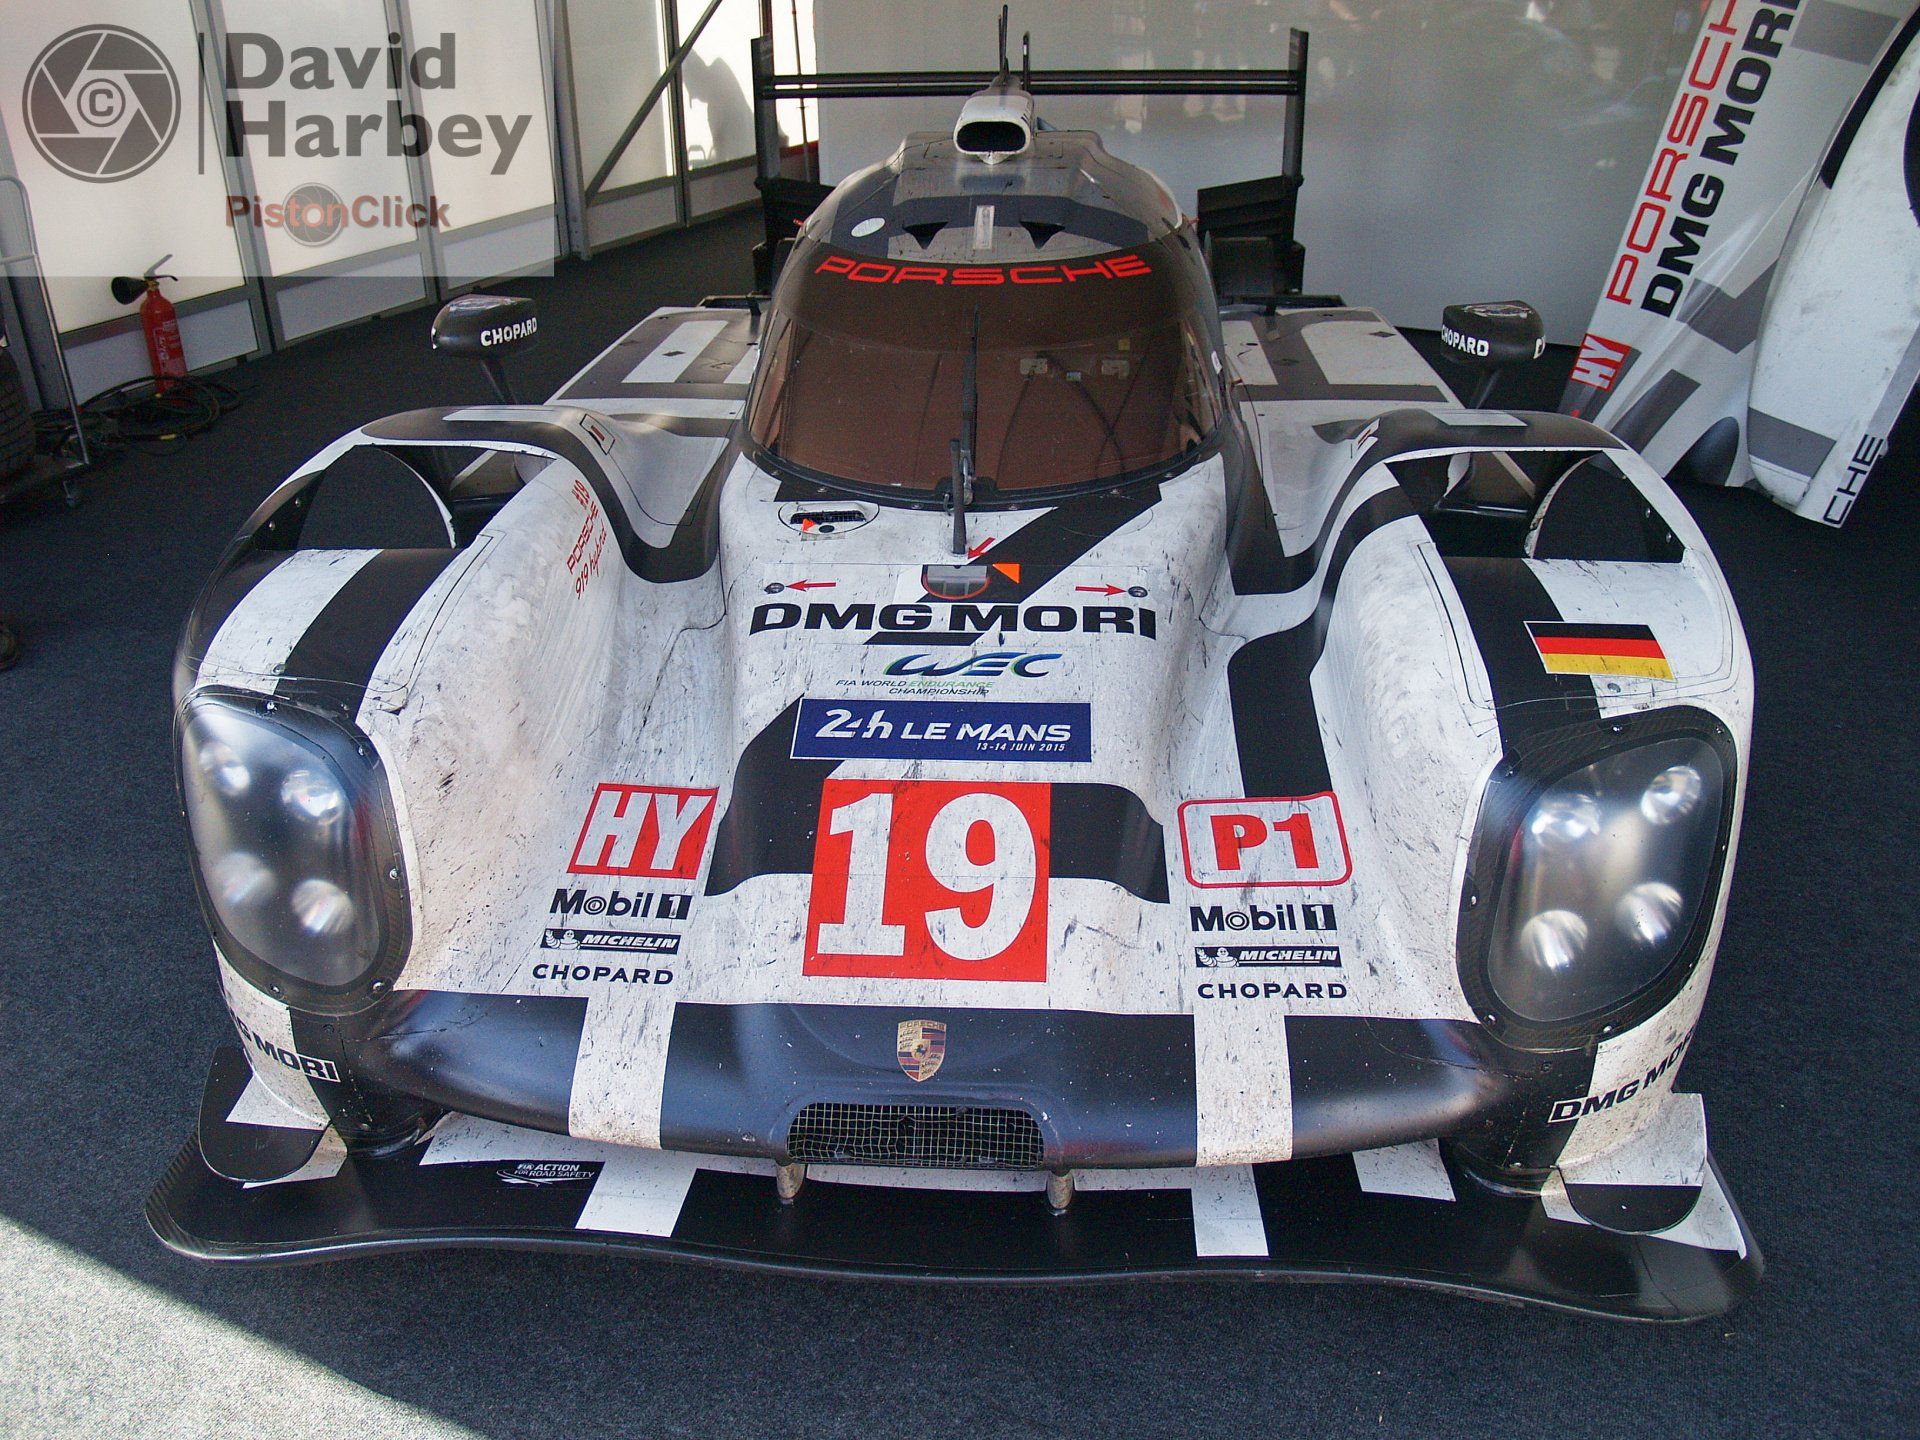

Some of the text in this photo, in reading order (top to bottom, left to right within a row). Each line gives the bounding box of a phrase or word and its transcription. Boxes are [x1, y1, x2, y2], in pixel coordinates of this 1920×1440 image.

[1640, 173, 1724, 318] DMG
[815, 254, 1152, 286] PORSCHE
[480, 317, 538, 347] CHOPARD
[1441, 324, 1489, 357] CHOPARD
[1571, 335, 1625, 390] HY
[1823, 434, 1884, 525] CHE
[567, 500, 599, 575] PORSCHE
[575, 562, 589, 601] 919
[749, 602, 1157, 641] DMG MORI
[882, 652, 1063, 678] WEC
[835, 679, 995, 688] FIA WORLD ENDURANCE
[888, 687, 990, 696] CHAMPIONSHIP
[814, 708, 1071, 742] 24h LE MANS
[976, 742, 1066, 752] 13-14 JUIN 2015
[575, 790, 713, 871] HY
[1210, 812, 1320, 871] P1
[816, 792, 1037, 961] 19
[549, 888, 654, 918] Mobil
[1189, 903, 1298, 932] Mobil
[581, 933, 678, 949] MICHELIN
[1238, 949, 1338, 962] MICHELIN
[532, 963, 674, 985] CHOPARD
[1197, 982, 1348, 1000] CHOPARD
[252, 1030, 339, 1081] MORI
[1551, 1079, 1640, 1121] DMG
[534, 1163, 580, 1172] ACTION
